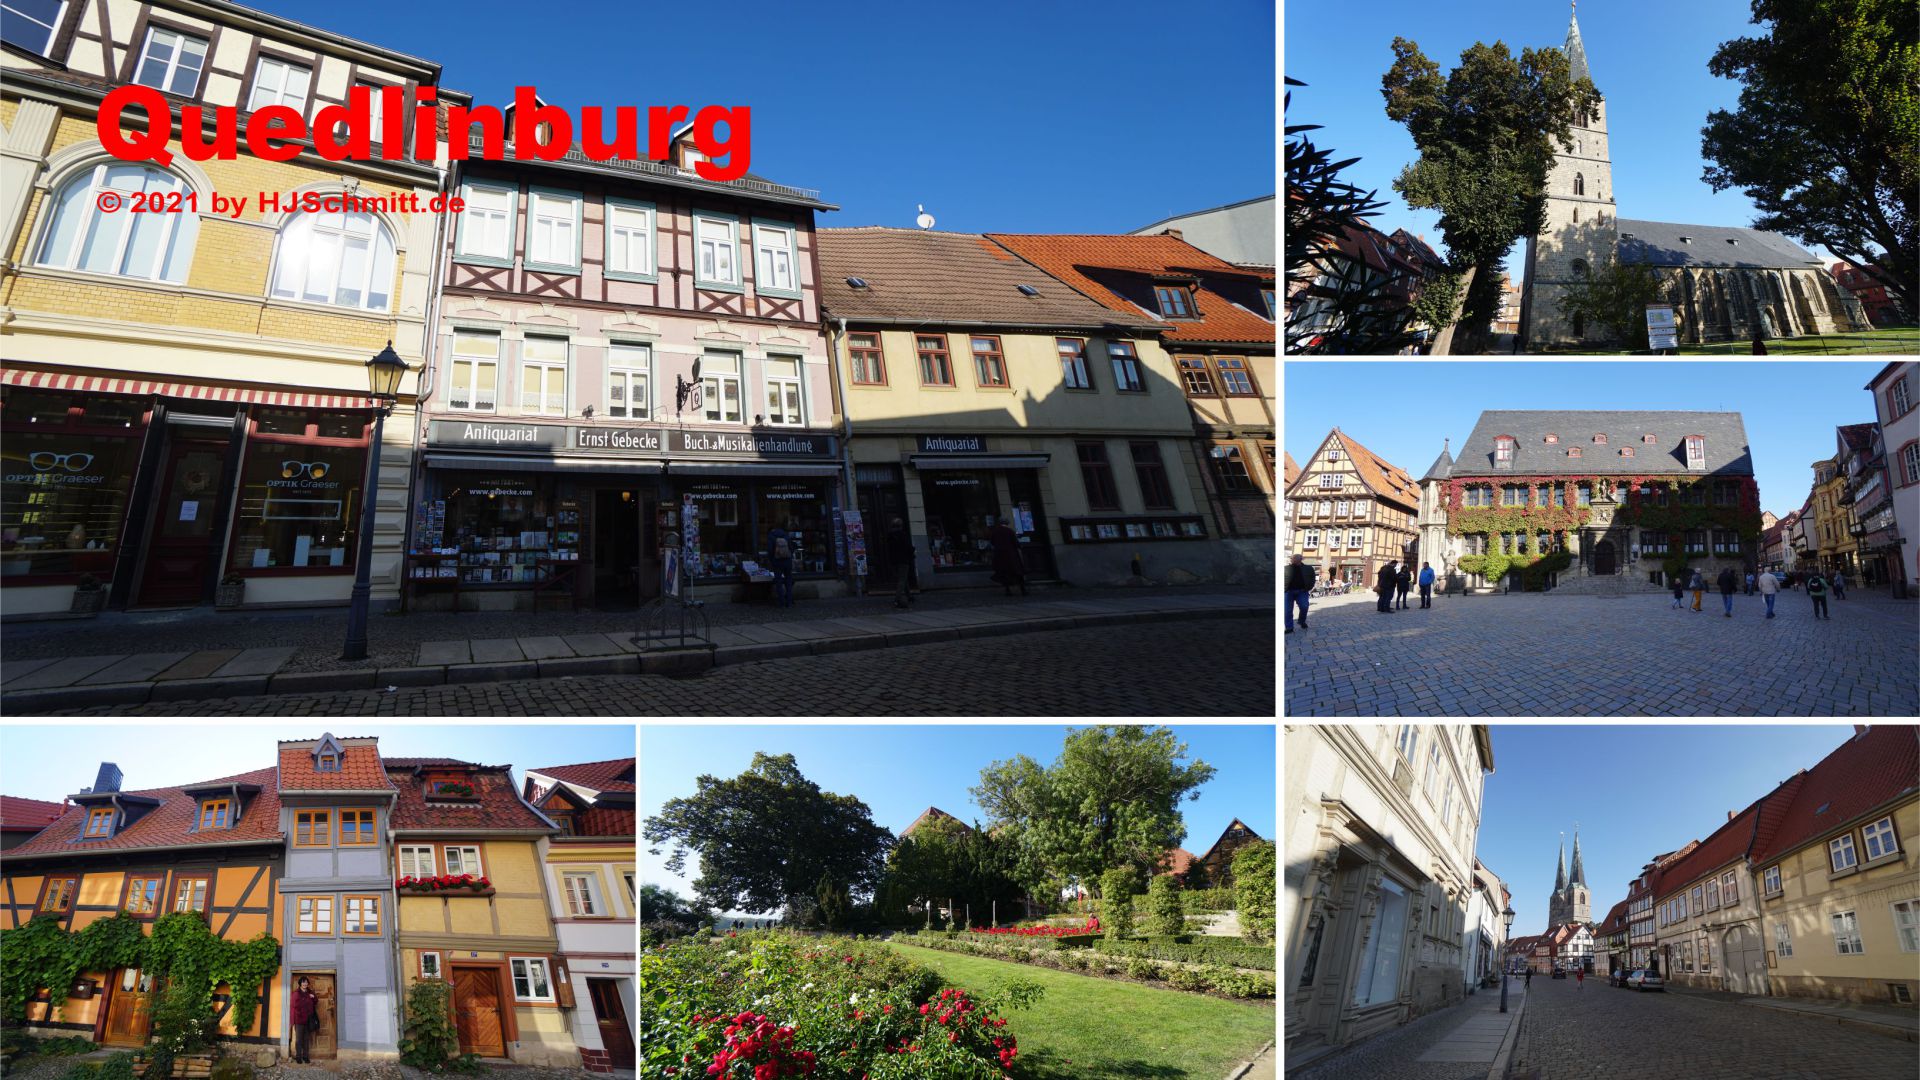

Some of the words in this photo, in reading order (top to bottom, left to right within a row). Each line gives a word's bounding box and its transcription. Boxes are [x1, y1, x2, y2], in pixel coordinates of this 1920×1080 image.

[463, 423, 538, 444] Antiquariat
[579, 430, 609, 447] Ernst
[611, 431, 658, 449] Gebecke
[925, 435, 980, 452] Antiquariat
[52, 473, 105, 484] Graeser
[266, 479, 298, 488] OPTIK
[300, 479, 341, 489] Graeser
[469, 487, 533, 497] www.gebecke.com
[690, 492, 738, 500] ww.gebecke.com
